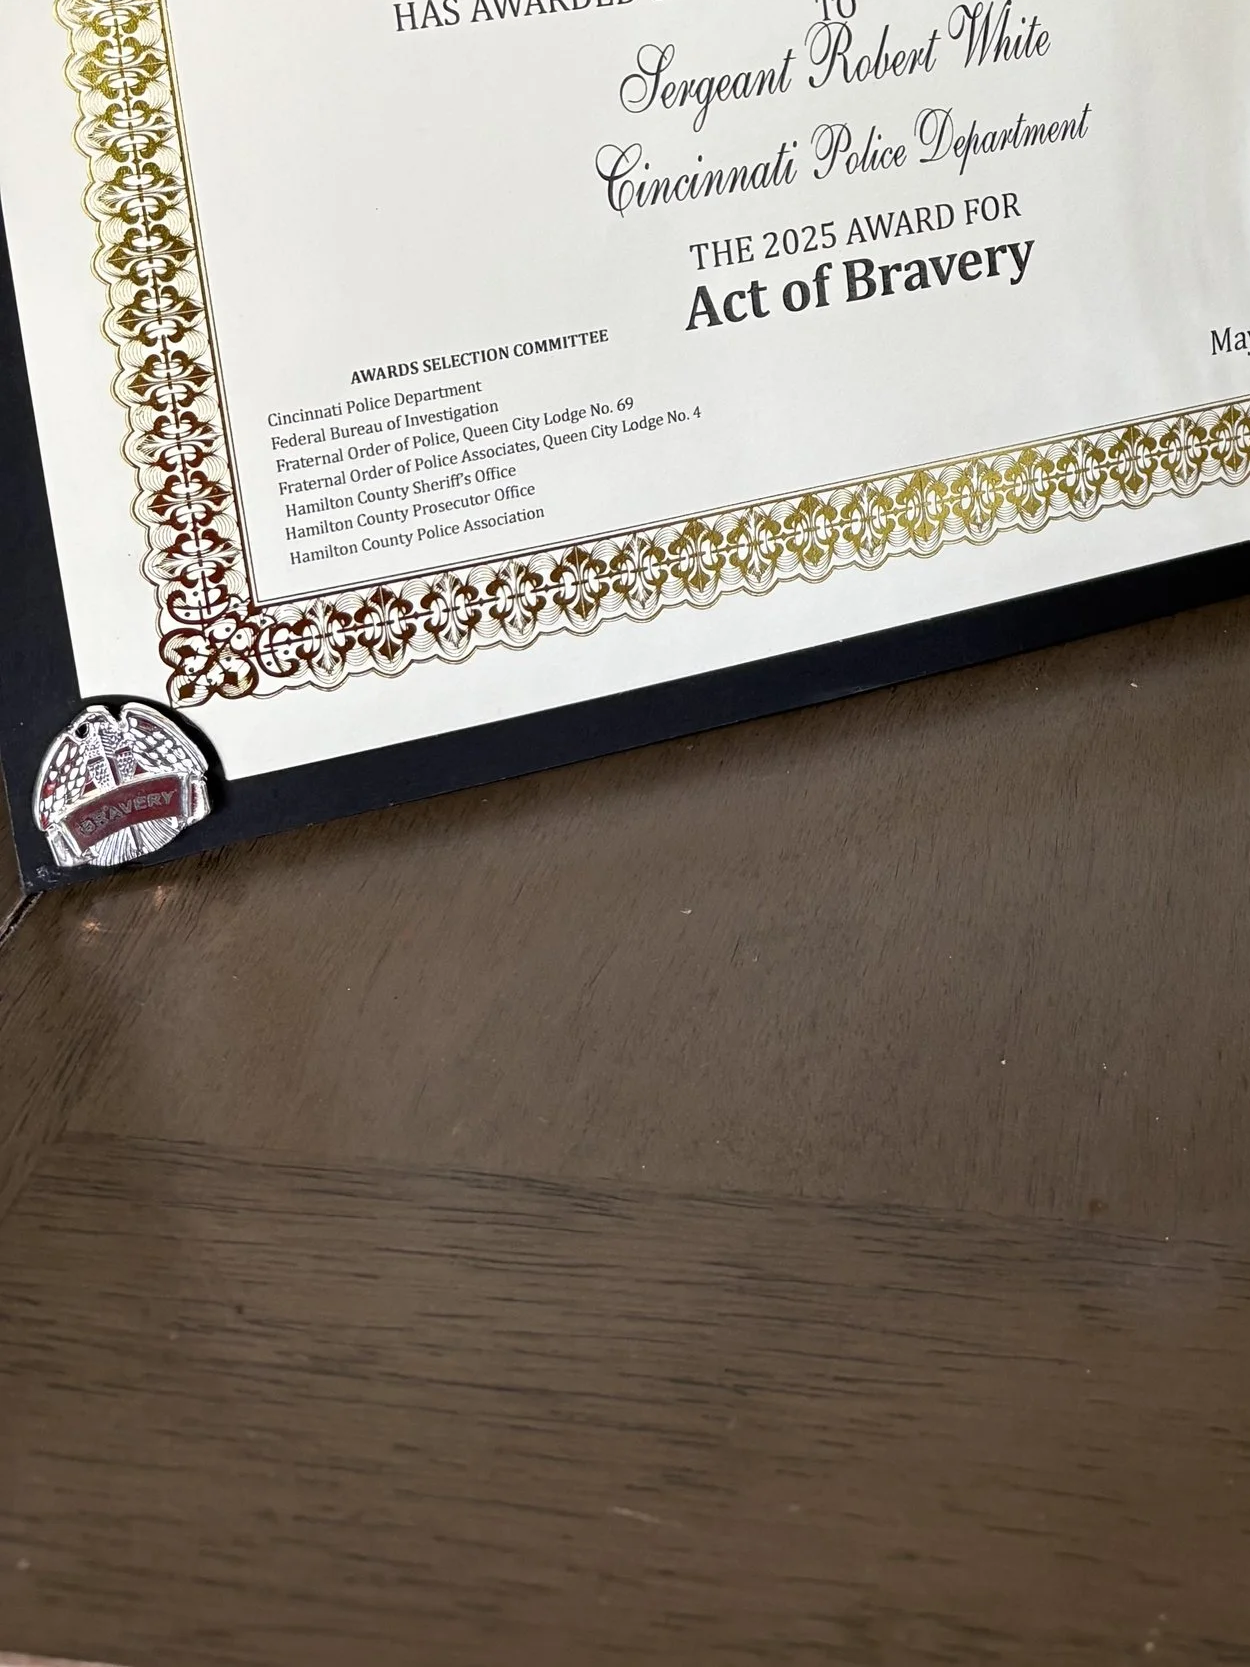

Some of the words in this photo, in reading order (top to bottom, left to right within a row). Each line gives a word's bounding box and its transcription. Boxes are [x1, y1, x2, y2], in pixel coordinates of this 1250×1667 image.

[619, 43, 796, 132] Sergeant
[805, 21, 941, 88] Robert
[948, 0, 1051, 69] White
[595, 141, 797, 218] Cincinnati
[811, 123, 907, 180] Police
[914, 102, 1092, 175] Department
[689, 236, 754, 270] THE
[763, 221, 836, 259] 2025
[846, 204, 954, 245] AWARD
[964, 193, 1021, 225] FOR
[685, 280, 770, 331] Act
[783, 262, 832, 312] of
[842, 240, 1035, 302] Bravery
[351, 361, 419, 385] AWARDS
[423, 346, 509, 372] SELECTION
[513, 329, 609, 357] COMMITTEE
[268, 403, 342, 427] Cincinnati
[346, 397, 390, 414] Police
[394, 381, 482, 406] Department
[271, 428, 326, 450] Federal
[330, 423, 383, 440] Bureau
[387, 415, 402, 430] of
[405, 403, 499, 427] Investigation
[276, 448, 343, 472] Fraternal
[348, 443, 391, 460] Order
[394, 437, 409, 452] of
[412, 432, 459, 449] Police,
[463, 423, 508, 442] Queen
[512, 417, 540, 431] City
[544, 408, 586, 425] Lodge
[590, 403, 613, 416] No.
[617, 397, 633, 411] 69
[278, 471, 346, 495] Fraternal
[350, 465, 393, 482] Order
[397, 459, 411, 474] of
[415, 455, 457, 471] Police
[461, 441, 540, 463] Associates,
[543, 431, 587, 449] Queen
[591, 425, 618, 438] City
[622, 416, 663, 433] Lodge
[667, 410, 689, 424] No.
[693, 406, 701, 418] 4
[285, 497, 354, 517] Hamilton
[358, 486, 409, 504] County
[475, 467, 516, 482] Office
[285, 519, 353, 540] Hamilton
[357, 509, 408, 527] County
[412, 494, 490, 517] Prosecutor
[495, 485, 535, 501] Office
[290, 544, 358, 565] Hamilton
[362, 533, 413, 551] County
[417, 525, 459, 541] Police
[464, 509, 544, 532] Association
[79, 789, 177, 836] BRAVERY
